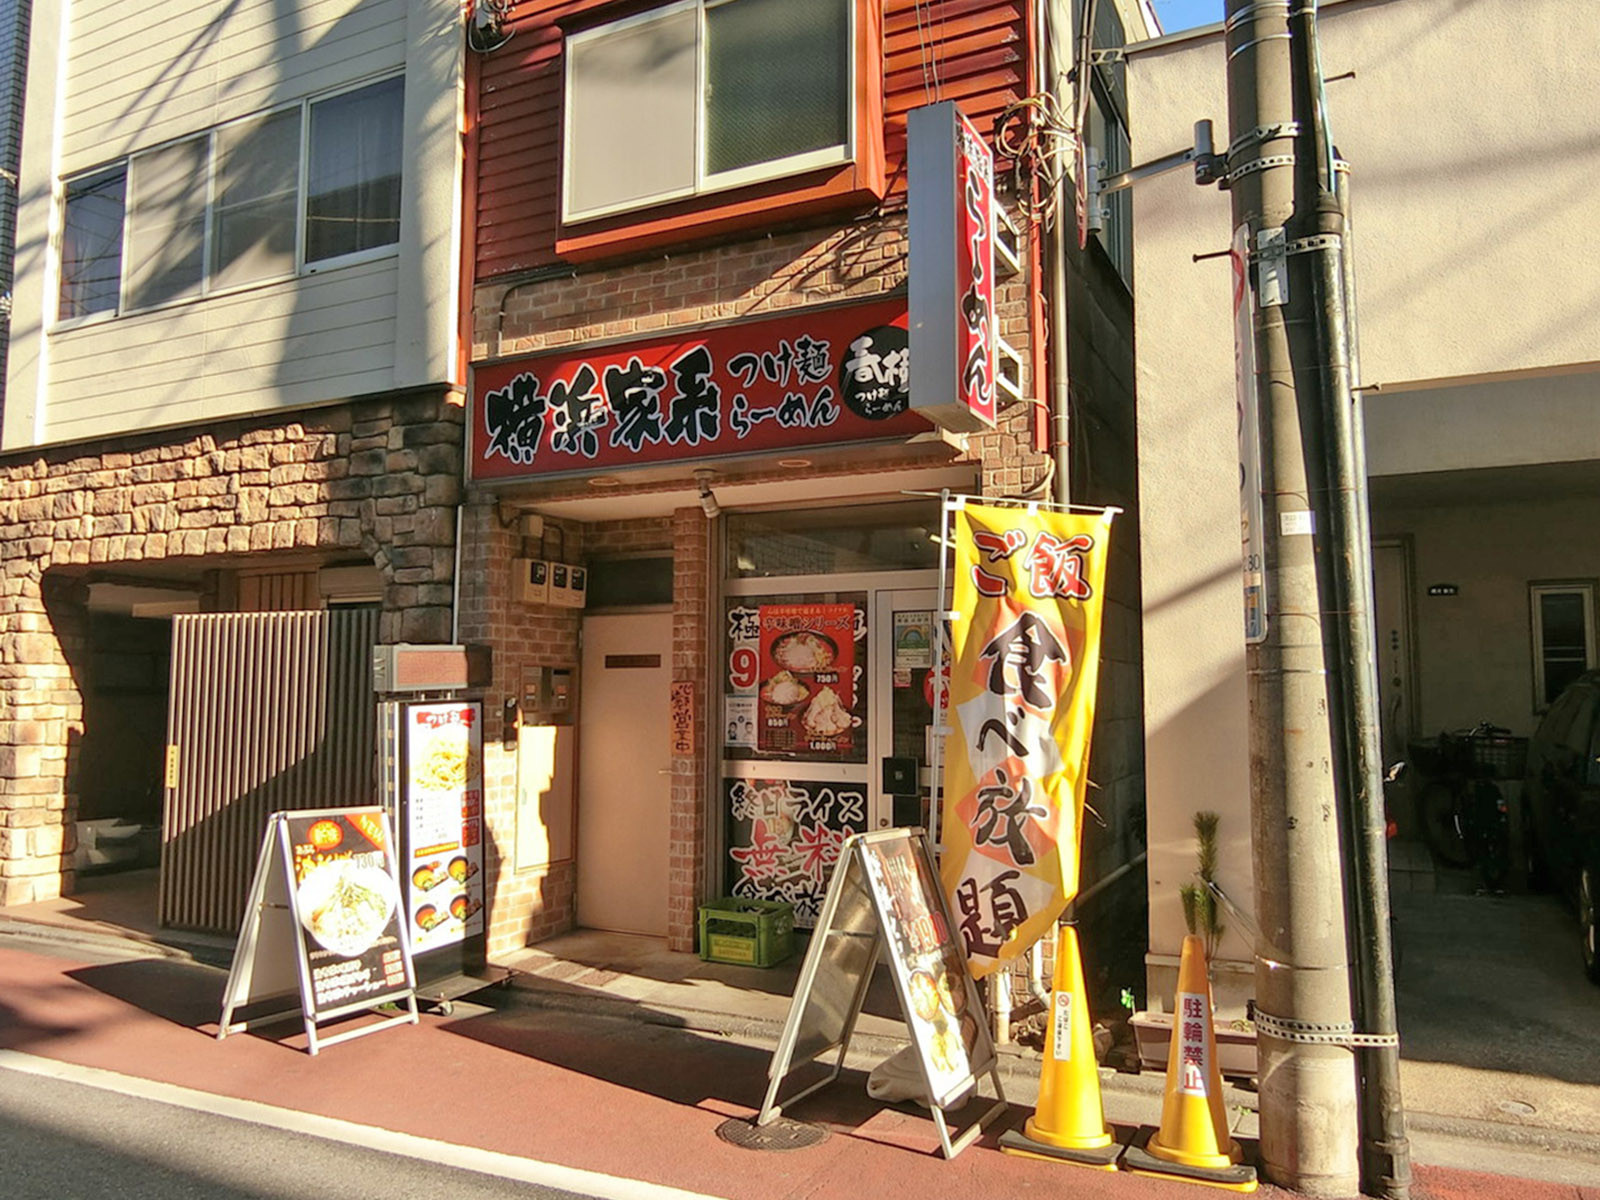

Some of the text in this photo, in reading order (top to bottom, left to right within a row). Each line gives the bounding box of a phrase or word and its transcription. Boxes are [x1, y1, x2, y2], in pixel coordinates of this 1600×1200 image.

[961, 166, 993, 406] らーめん
[729, 335, 832, 388] つけ麺
[484, 345, 721, 464] 横浜家系
[729, 386, 840, 438] らーめん
[971, 529, 1093, 599] ご飯
[730, 648, 758, 688] 9
[956, 611, 1070, 960] 食べ放題
[360, 815, 384, 843] NEW
[1183, 998, 1203, 1089] 駐輪禁止
